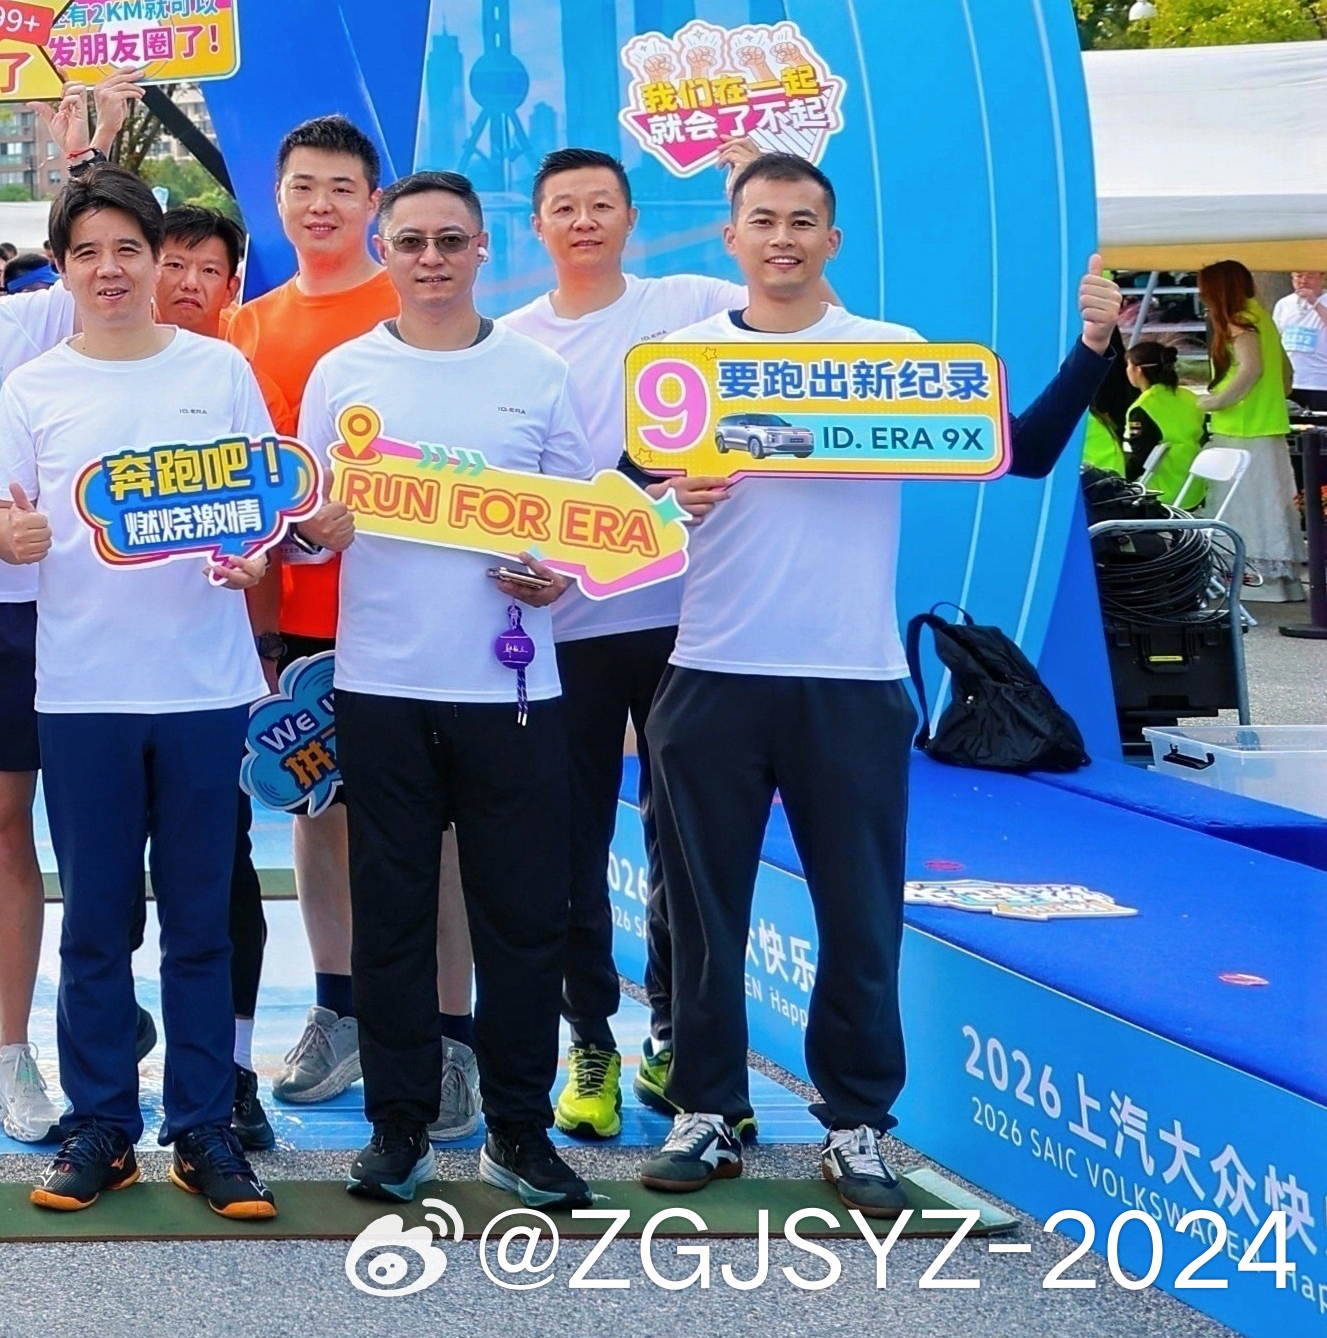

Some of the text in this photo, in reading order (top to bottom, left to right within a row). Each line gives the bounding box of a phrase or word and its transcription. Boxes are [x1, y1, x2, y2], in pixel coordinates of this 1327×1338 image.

[639, 64, 821, 114] 我们在一起
[647, 96, 831, 146] 就会了不起
[636, 358, 710, 453] 9
[717, 359, 990, 402] 要跑出新纪录
[822, 426, 984, 452] ID. ERA 9X
[124, 498, 263, 547] 燃烧激情
[343, 469, 657, 555] RUN FOR ERA
[607, 850, 648, 906] 026
[770, 985, 808, 1032] Happ
[971, 1097, 1023, 1148] 2026
[1030, 1130, 1078, 1179] SAIC
